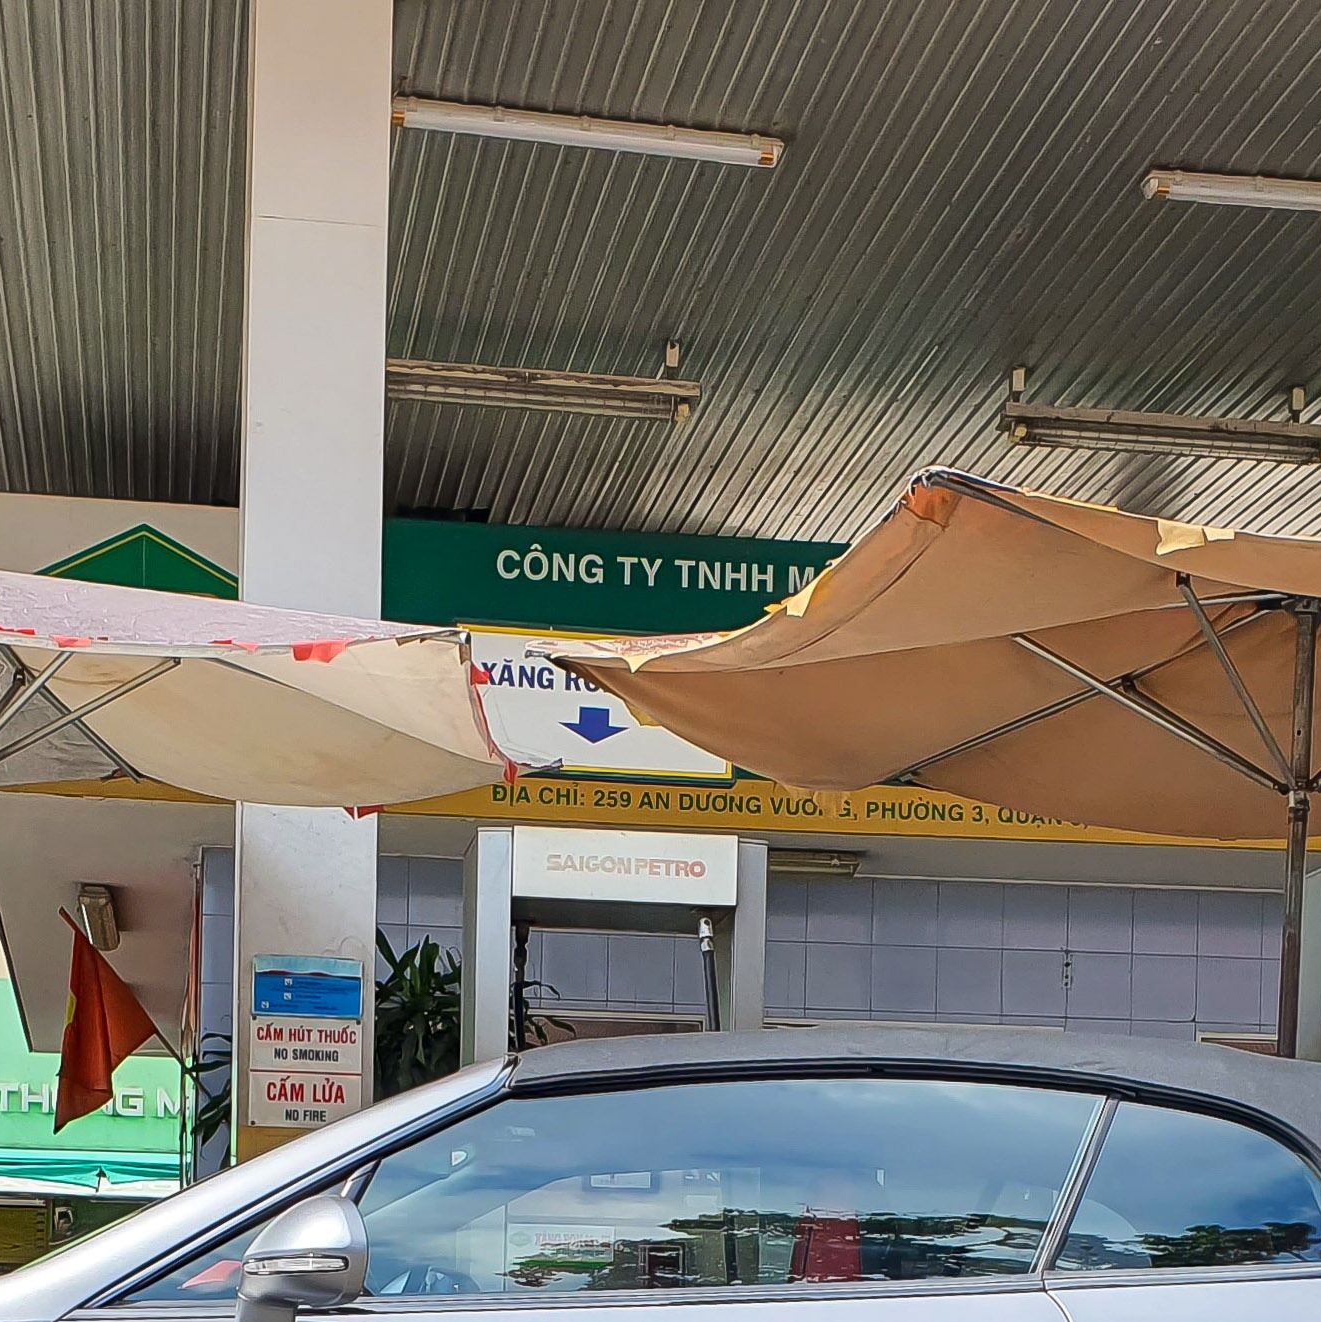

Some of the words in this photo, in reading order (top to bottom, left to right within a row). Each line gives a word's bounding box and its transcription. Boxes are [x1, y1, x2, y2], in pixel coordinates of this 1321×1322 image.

[496, 543, 604, 584] CÔNG
[617, 556, 663, 586] TY
[675, 559, 774, 593] TNHH
[481, 659, 554, 690] XĂNG
[492, 783, 530, 807] ĐỊA
[538, 782, 585, 806] CHỈ:
[593, 789, 632, 808] 259
[638, 791, 670, 810] AN
[678, 790, 762, 814] DƯƠNG
[770, 796, 858, 820] VƯƠG,
[866, 796, 964, 823] PHƯỜNG
[971, 805, 991, 825] 3,
[256, 1022, 284, 1041] CẤM
[289, 1025, 313, 1042] HÚT
[317, 1025, 357, 1044] THUỐC
[274, 1048, 288, 1060] NO
[292, 1048, 339, 1062] SMOKING
[266, 1076, 305, 1103] CẤM
[312, 1078, 345, 1104] LỬA
[285, 1109, 299, 1121] NO
[303, 1110, 327, 1122] FIRE
